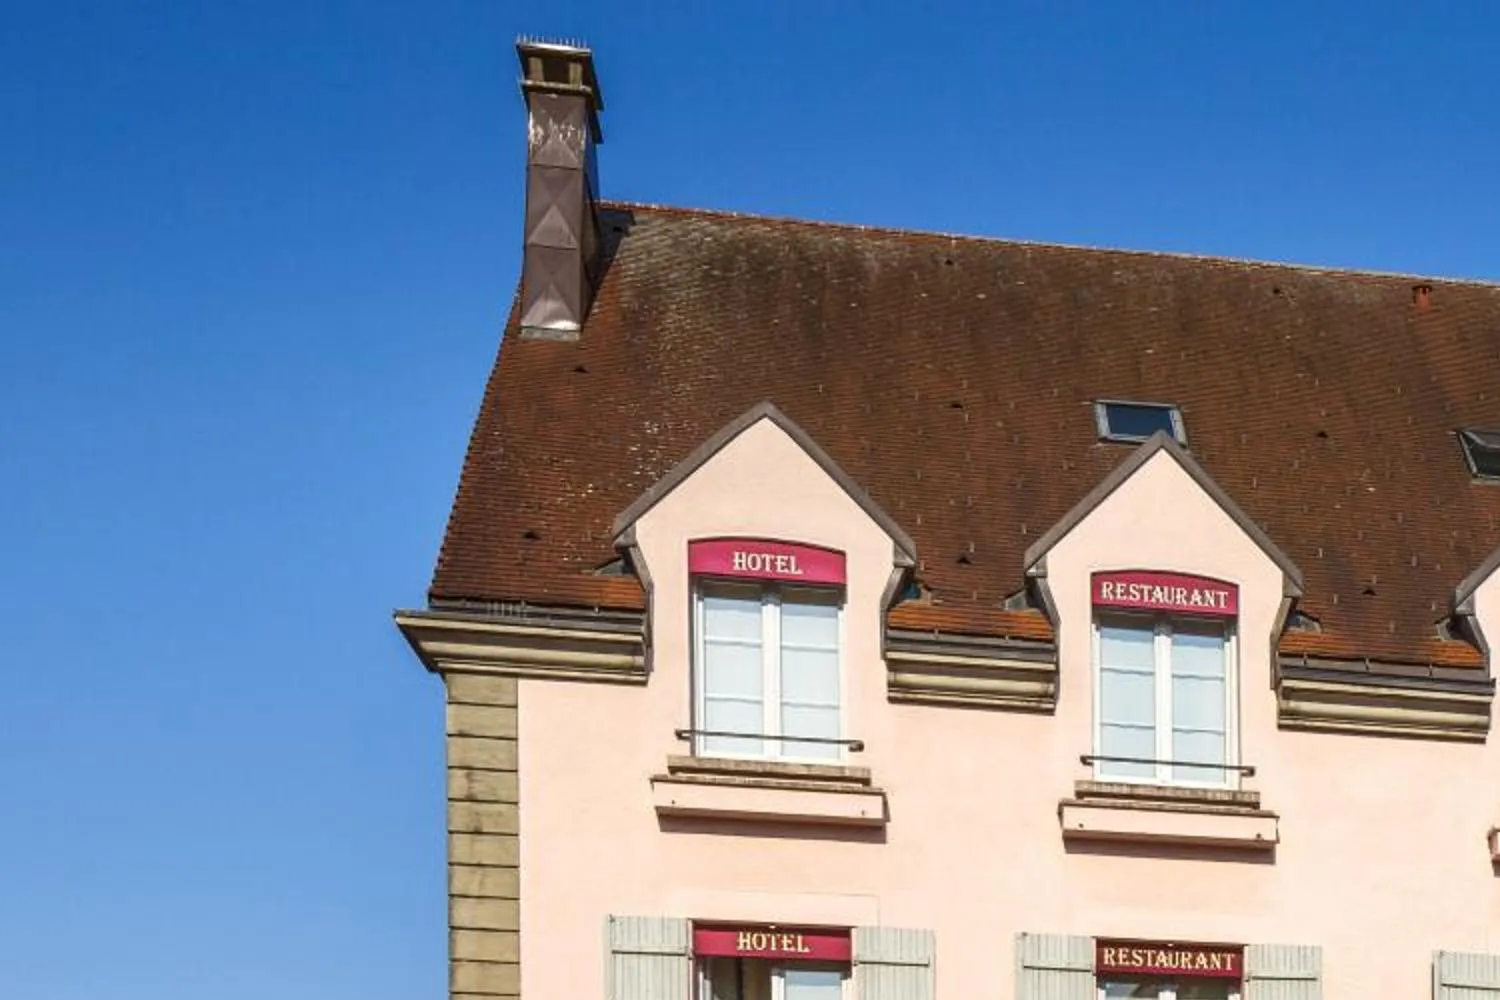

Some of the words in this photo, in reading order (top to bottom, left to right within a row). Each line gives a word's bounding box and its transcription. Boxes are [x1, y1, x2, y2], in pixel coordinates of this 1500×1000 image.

[733, 551, 803, 575] HOTEL
[1101, 581, 1228, 609] RESTAURANT
[736, 931, 810, 953] HOTEL
[1103, 946, 1235, 971] RESTAURANT
